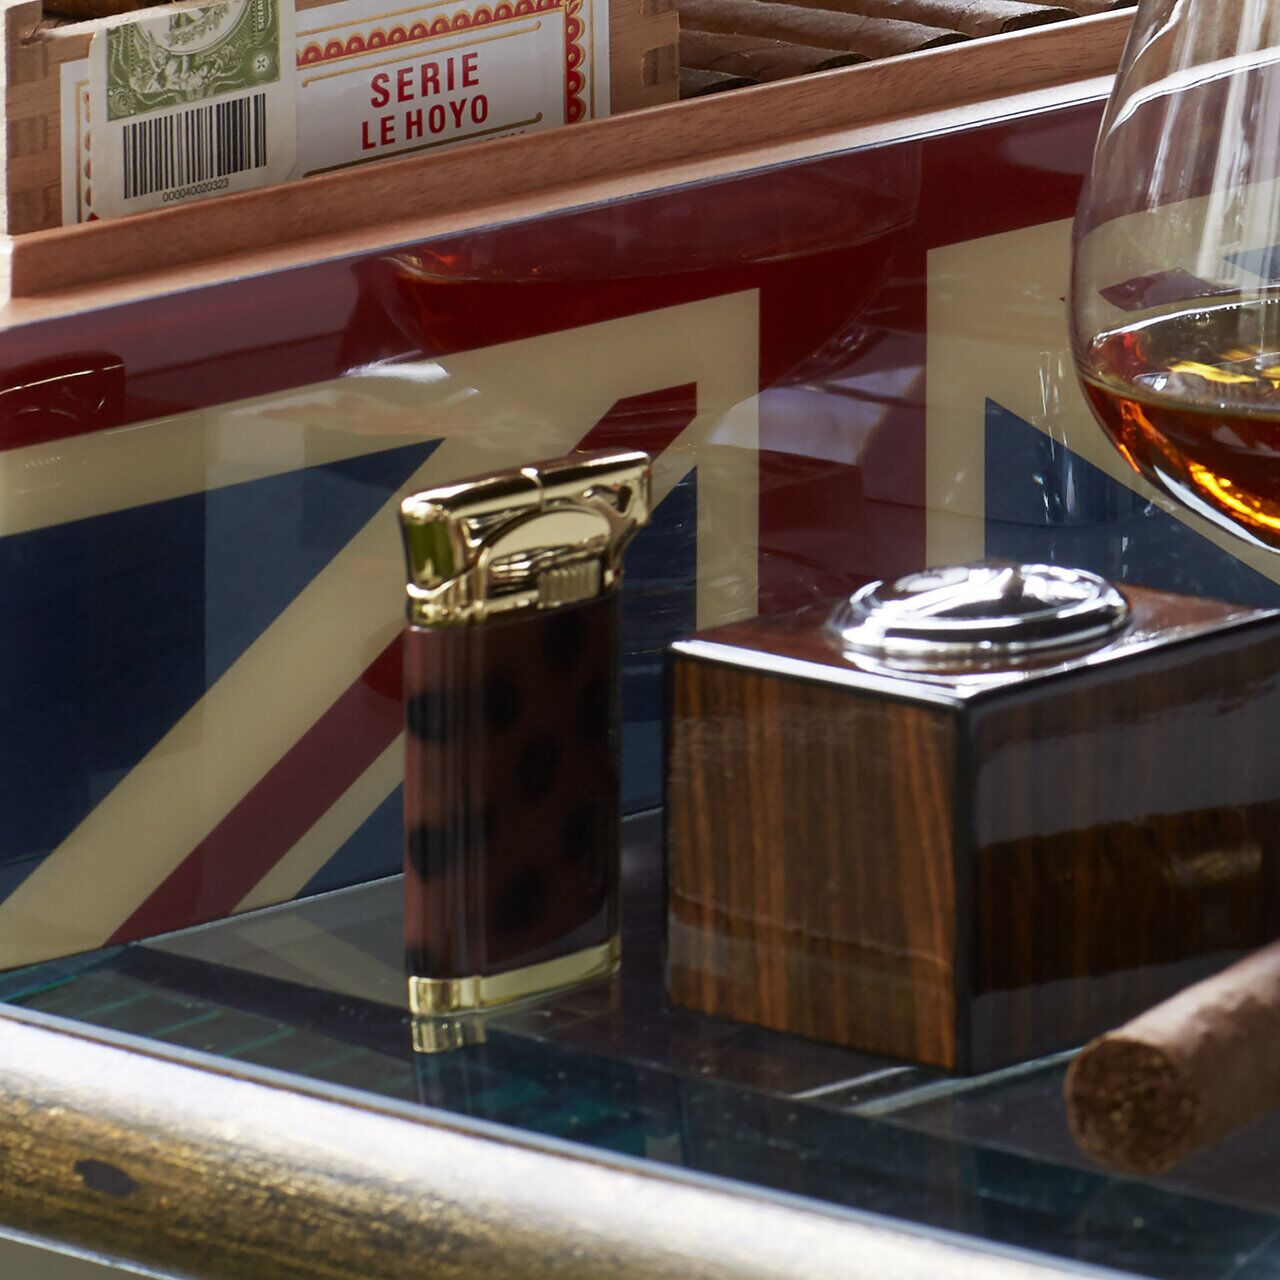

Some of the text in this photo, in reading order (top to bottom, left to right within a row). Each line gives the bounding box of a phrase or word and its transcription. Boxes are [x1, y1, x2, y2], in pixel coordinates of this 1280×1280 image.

[370, 52, 479, 108] SERIE
[362, 94, 488, 150] LE HOYO
